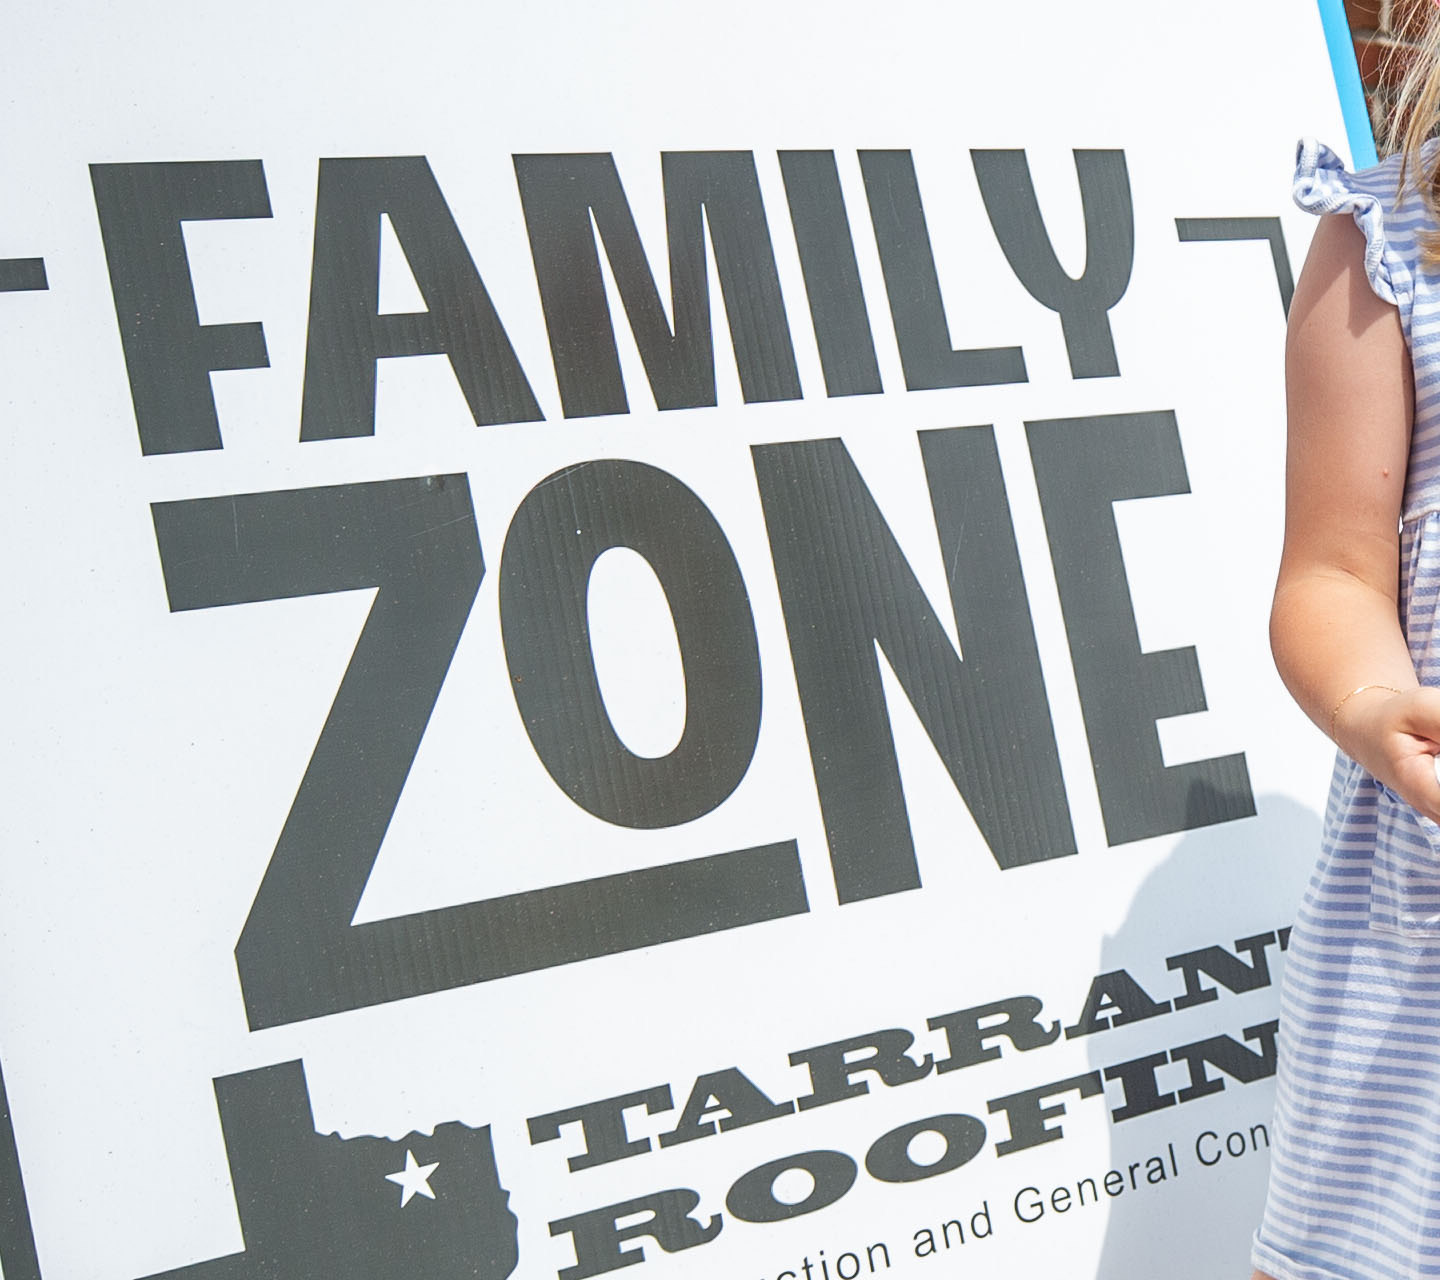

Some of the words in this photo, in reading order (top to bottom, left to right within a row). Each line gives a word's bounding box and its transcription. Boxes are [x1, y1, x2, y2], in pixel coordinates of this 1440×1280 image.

[87, 147, 1136, 457] FAMILY
[149, 409, 1258, 1033] ZONE
[526, 925, 1293, 1174] TARRAN
[911, 1201, 995, 1258] and
[1012, 1143, 1180, 1224] General
